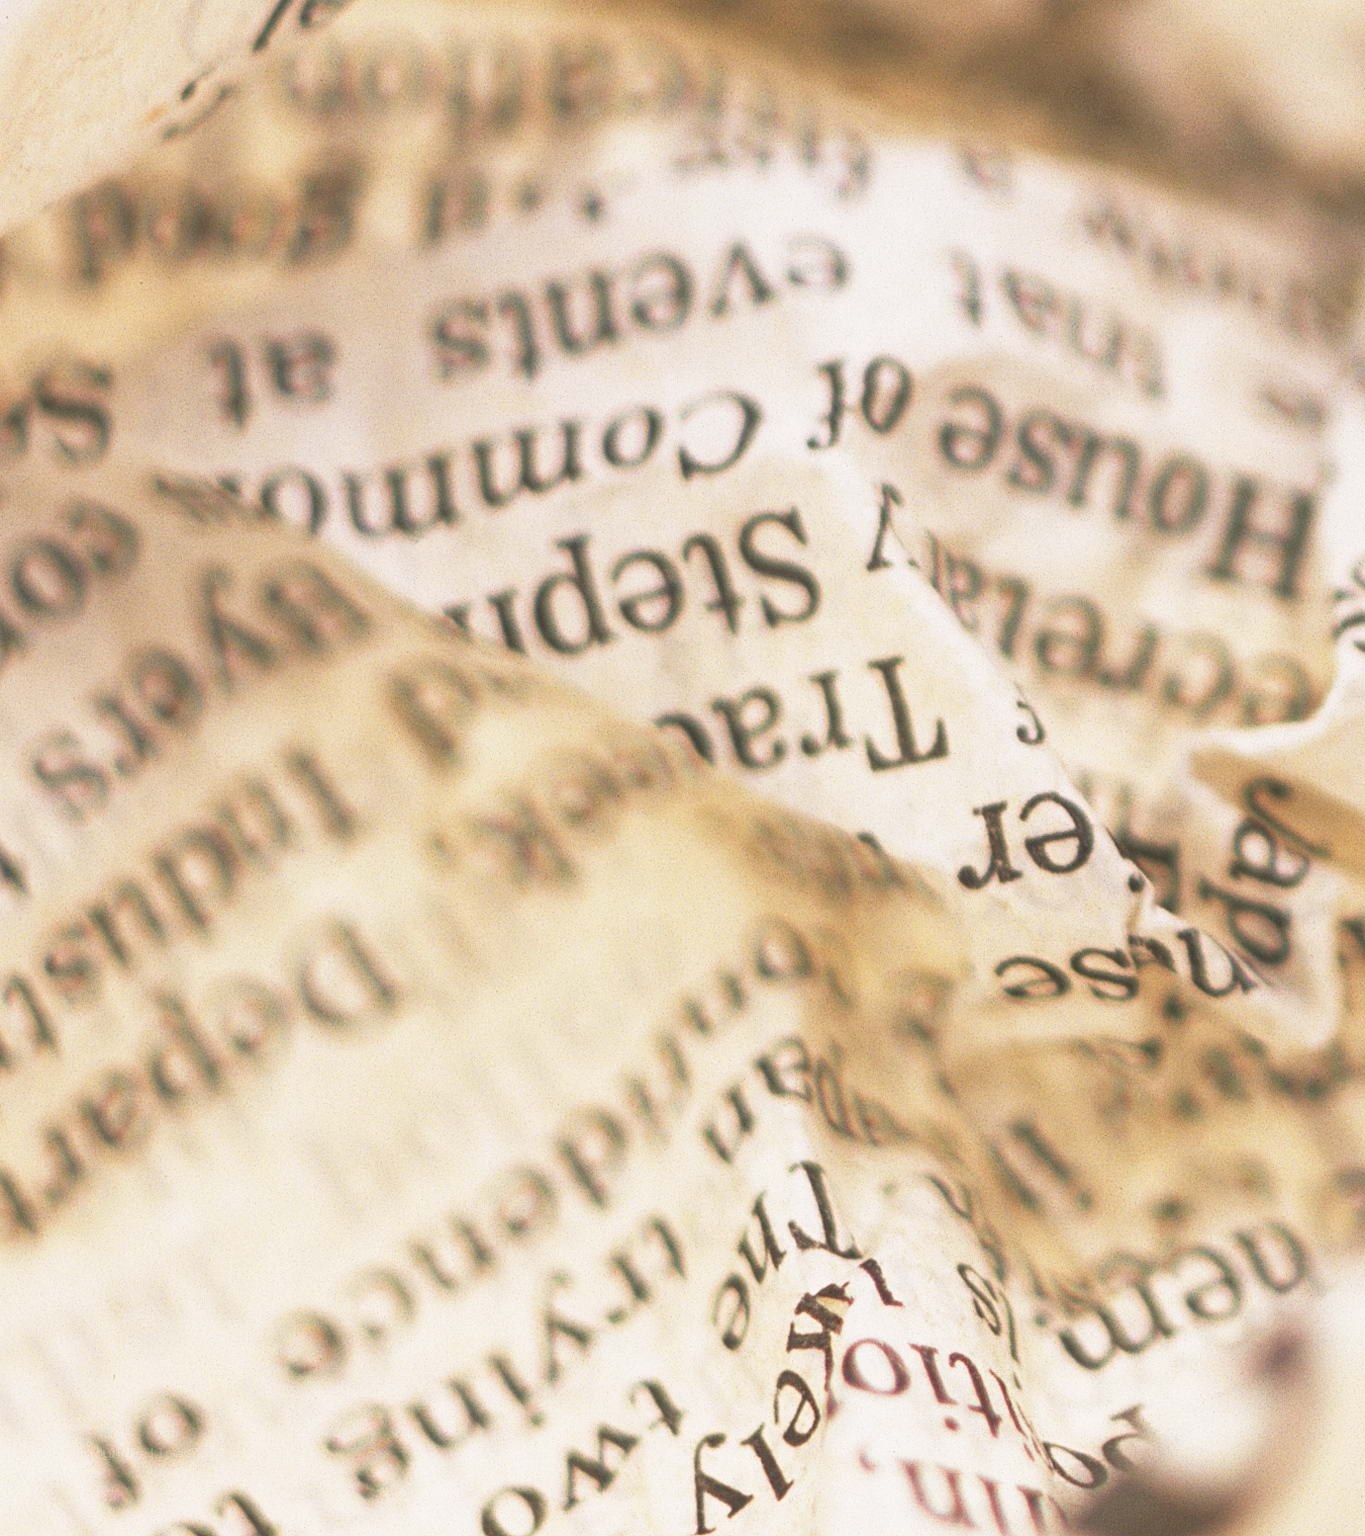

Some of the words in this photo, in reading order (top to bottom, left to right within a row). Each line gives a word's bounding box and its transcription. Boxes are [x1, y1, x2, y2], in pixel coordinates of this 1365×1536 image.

[205, 332, 342, 434] at
[422, 229, 856, 386] events
[808, 354, 914, 456] of
[934, 379, 1312, 604] House
[322, 1212, 692, 1504] trying
[86, 1389, 210, 1516] of
[478, 1374, 688, 1536] two
